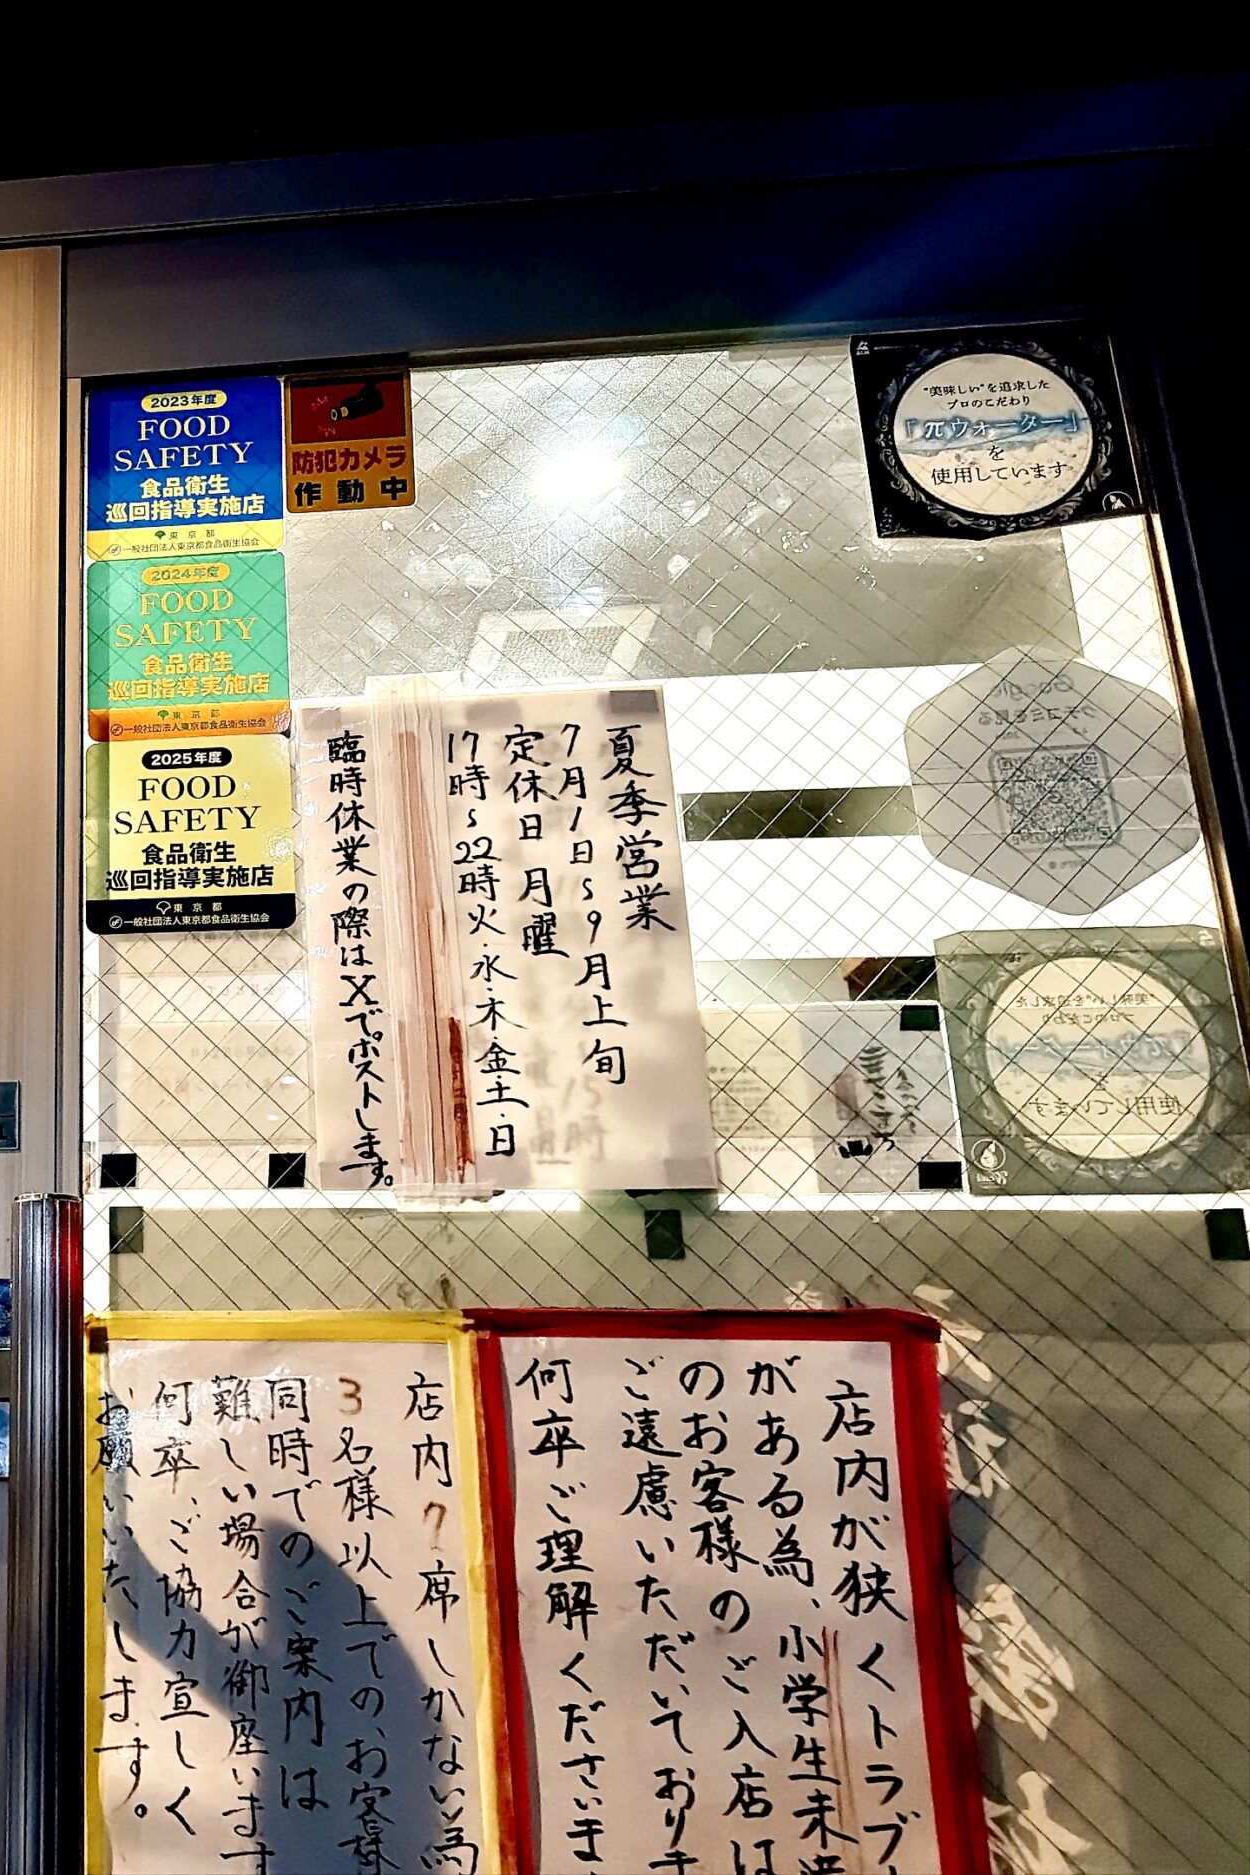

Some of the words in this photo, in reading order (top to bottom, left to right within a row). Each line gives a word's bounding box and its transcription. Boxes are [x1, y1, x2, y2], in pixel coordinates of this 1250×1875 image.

[150, 393, 218, 408] 2023年度
[137, 415, 231, 441] FOOD
[114, 441, 254, 472] SAFETY
[292, 446, 406, 475] 防犯カメラ
[988, 445, 1005, 461] を
[140, 474, 231, 499] 食品衛生
[931, 461, 1068, 486] 使用しています
[294, 476, 408, 507] 作動中
[105, 494, 265, 523] 巡回指導実施店
[150, 566, 220, 582] 2024年度
[139, 588, 234, 616] FOOD
[115, 617, 257, 648] SAFETY
[141, 651, 234, 677] 食品衛生
[107, 673, 270, 700] 巡回指導実施店
[150, 750, 222, 767] 2025年度
[138, 775, 237, 801] FOOD
[114, 806, 262, 835] SAFETY
[601, 724, 676, 932] 夏季営業
[141, 841, 237, 866] 食品衛生
[105, 864, 275, 892] 巡回指導実施店
[173, 902, 222, 914] 東京都
[266, 1376, 334, 1812] 同時でのご案内は
[403, 1371, 479, 1875] 店内7席しかない為
[515, 1357, 607, 1875] 何卒ご理解くださいま
[821, 1378, 921, 1875] 店内が狭くトラブ
